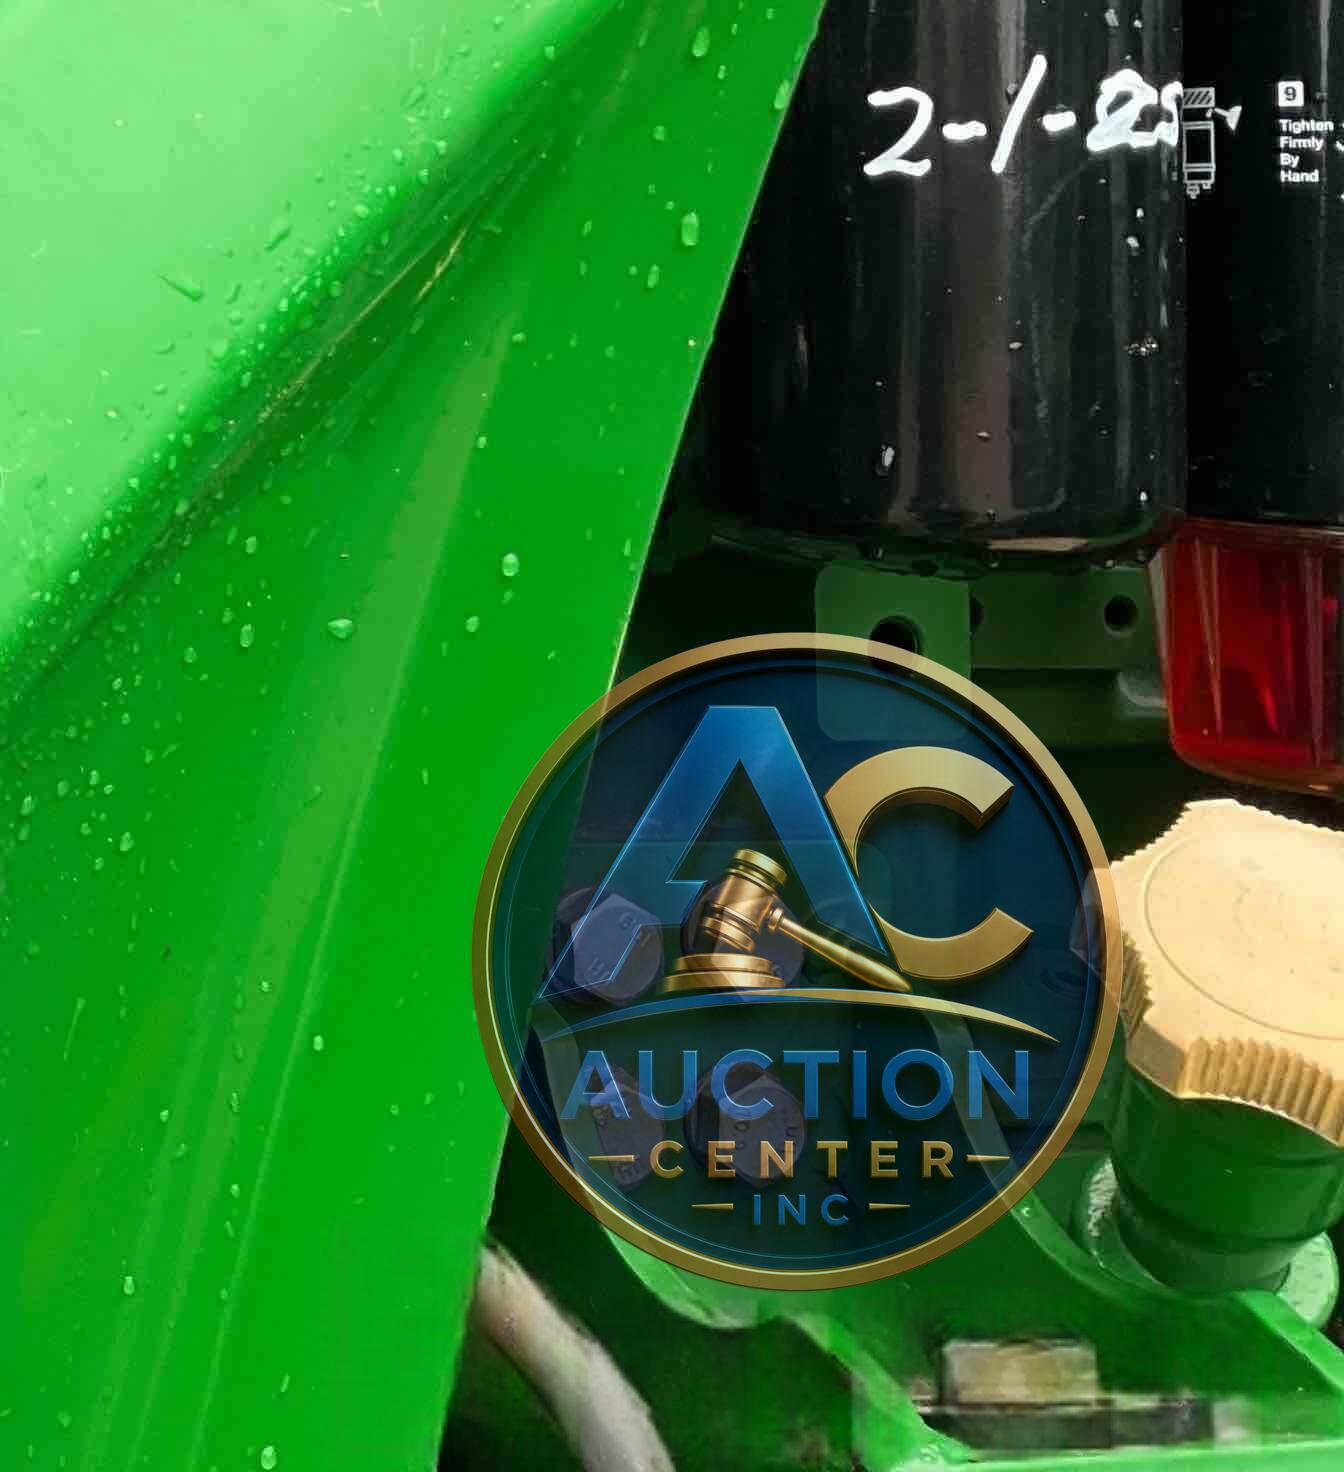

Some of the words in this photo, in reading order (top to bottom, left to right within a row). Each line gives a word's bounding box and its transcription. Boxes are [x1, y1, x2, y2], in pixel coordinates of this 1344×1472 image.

[1278, 118, 1334, 134] Tighten
[1279, 135, 1324, 151] Firmly
[1279, 153, 1300, 168] By
[1280, 169, 1319, 183] Hand
